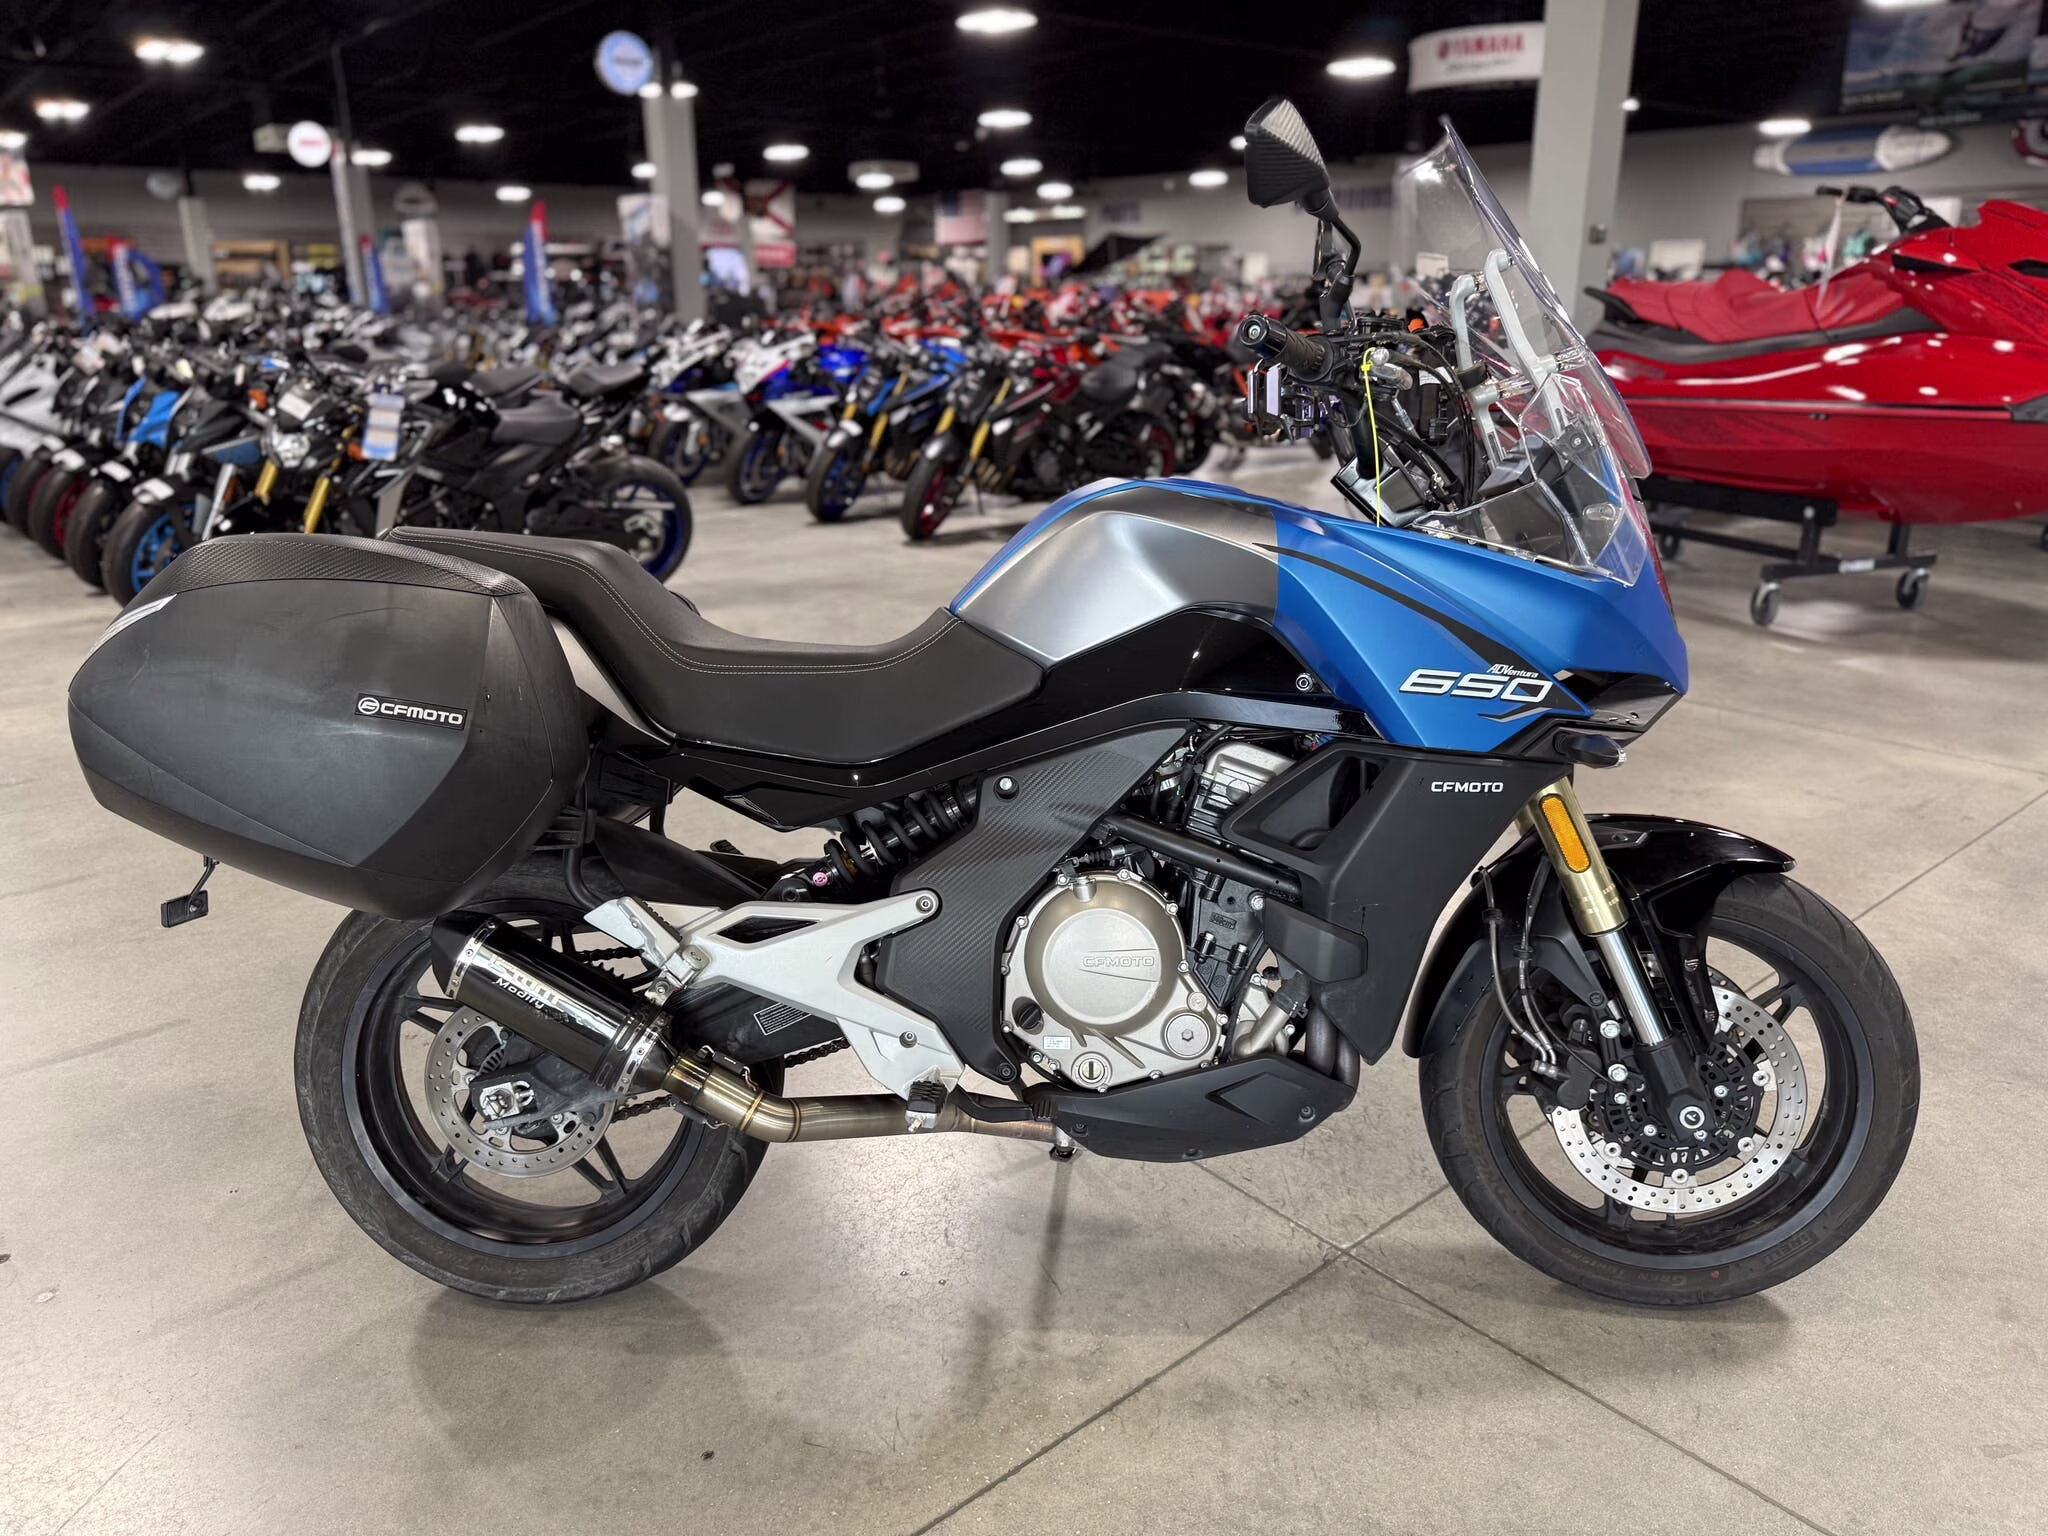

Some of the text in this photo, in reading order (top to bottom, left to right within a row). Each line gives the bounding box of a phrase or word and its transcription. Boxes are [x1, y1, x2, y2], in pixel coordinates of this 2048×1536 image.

[1486, 663, 1539, 679] ADVentura
[1399, 668, 1553, 703] 650
[380, 702, 463, 725] CFMOTO
[1430, 781, 1504, 793] CFMOTO
[1082, 955, 1155, 968] CFMOTO
[495, 977, 545, 1010] Modify
